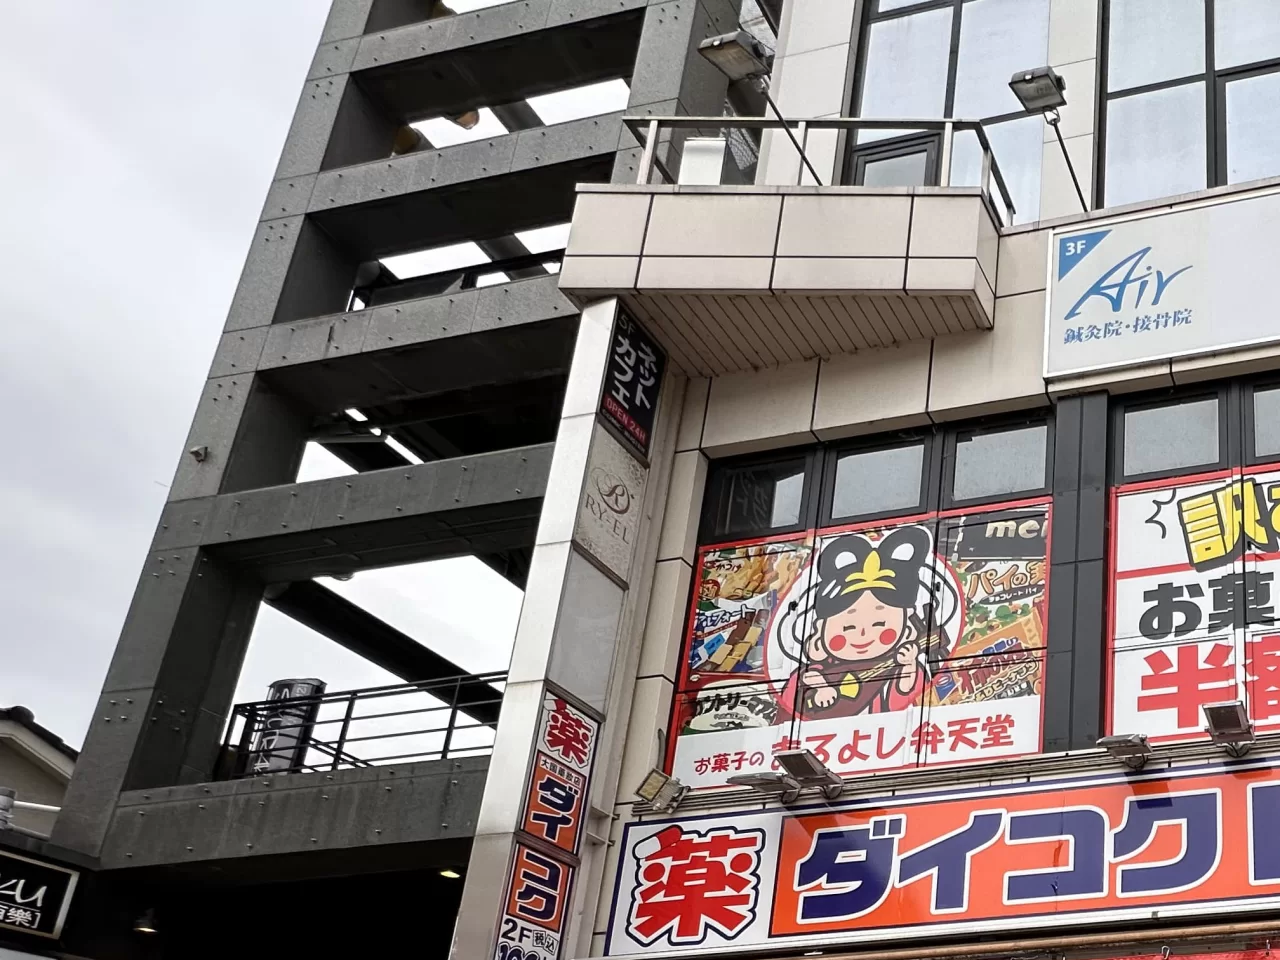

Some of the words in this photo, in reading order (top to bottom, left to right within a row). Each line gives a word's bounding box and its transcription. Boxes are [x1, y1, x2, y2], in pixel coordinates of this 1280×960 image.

[1064, 246, 1193, 320] Air
[1065, 240, 1086, 257] 3F
[611, 335, 636, 410] カフェ
[606, 397, 630, 425] OPEN
[629, 421, 647, 446] 24H
[585, 493, 630, 545] RY-EL
[544, 699, 595, 768] 薬
[515, 775, 579, 921] ダイコク
[626, 824, 766, 946] 薬
[502, 918, 531, 944] 2F
